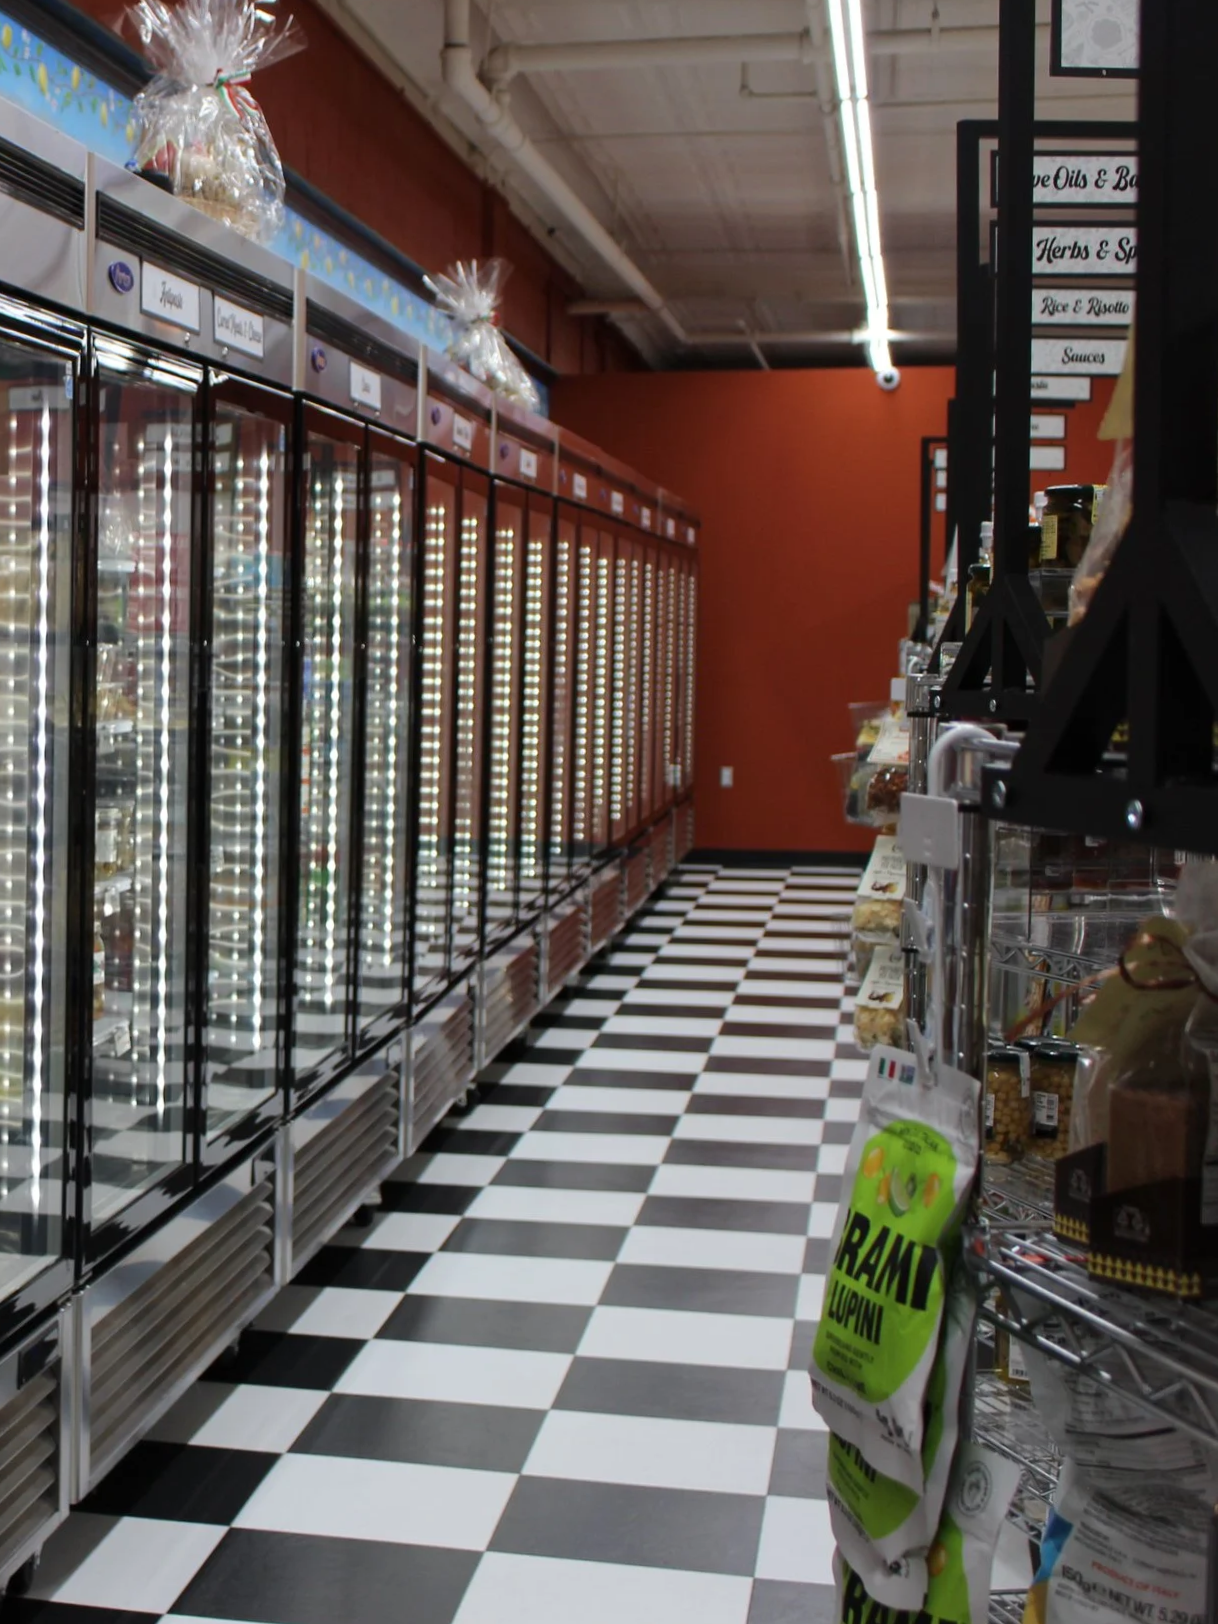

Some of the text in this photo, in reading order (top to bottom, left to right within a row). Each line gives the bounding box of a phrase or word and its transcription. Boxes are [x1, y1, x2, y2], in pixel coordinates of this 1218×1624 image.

[1054, 166, 1087, 191] Oils
[1095, 169, 1108, 188] &
[1036, 237, 1090, 263] Herbs
[1097, 240, 1110, 259] &
[1041, 297, 1129, 316] Rice & Risotto
[1061, 347, 1105, 364] Sauces
[828, 1280, 884, 1346] LUPINI
[1108, 1588, 1131, 1608] NET
[1133, 1601, 1155, 1617] WT
